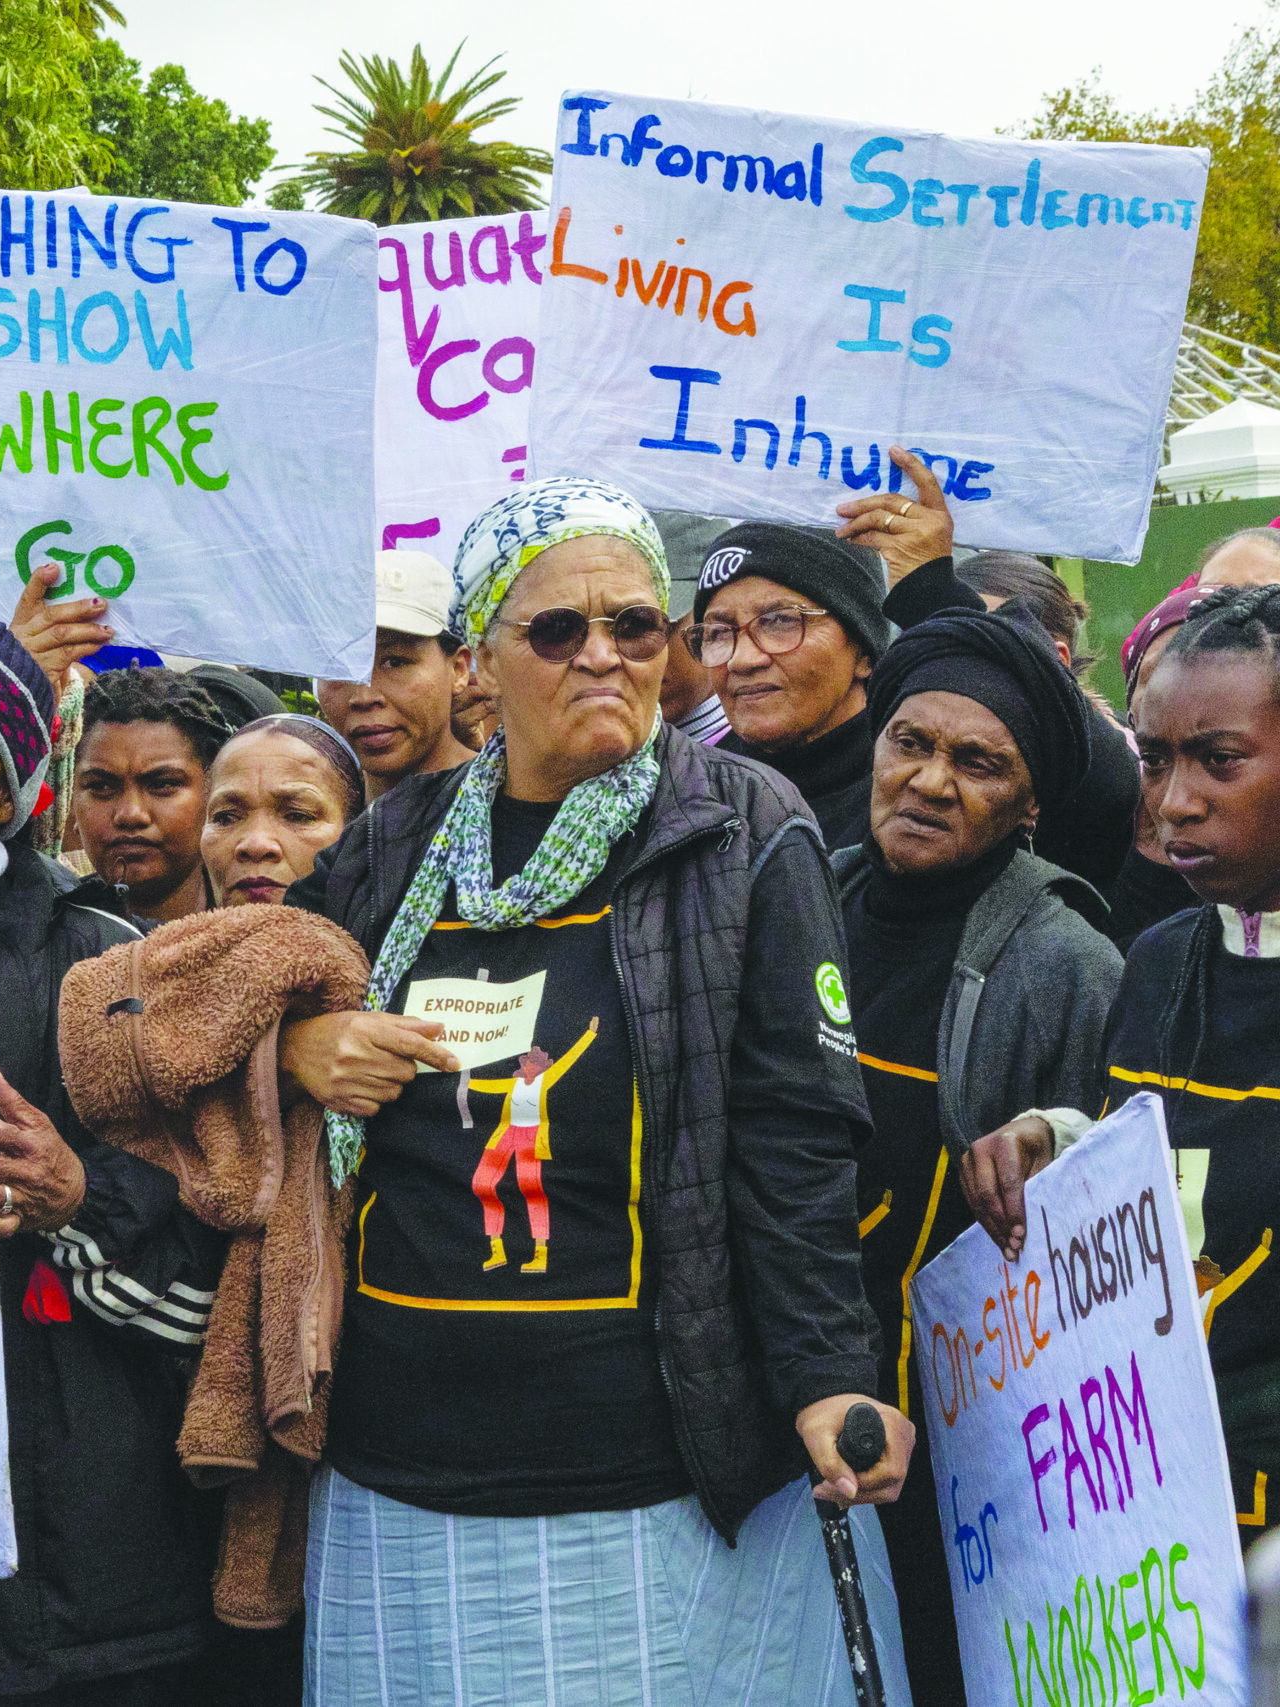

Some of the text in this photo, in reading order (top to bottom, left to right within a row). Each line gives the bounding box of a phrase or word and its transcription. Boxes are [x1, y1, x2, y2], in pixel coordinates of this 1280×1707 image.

[561, 97, 824, 206] Informal
[423, 995, 525, 1015] EXPROPRIATE
[473, 1025, 509, 1043] NOW!
[1041, 1186, 1174, 1337] housing
[951, 1351, 1163, 1592] for FARM
[1005, 1541, 1206, 1707] WORKERS
